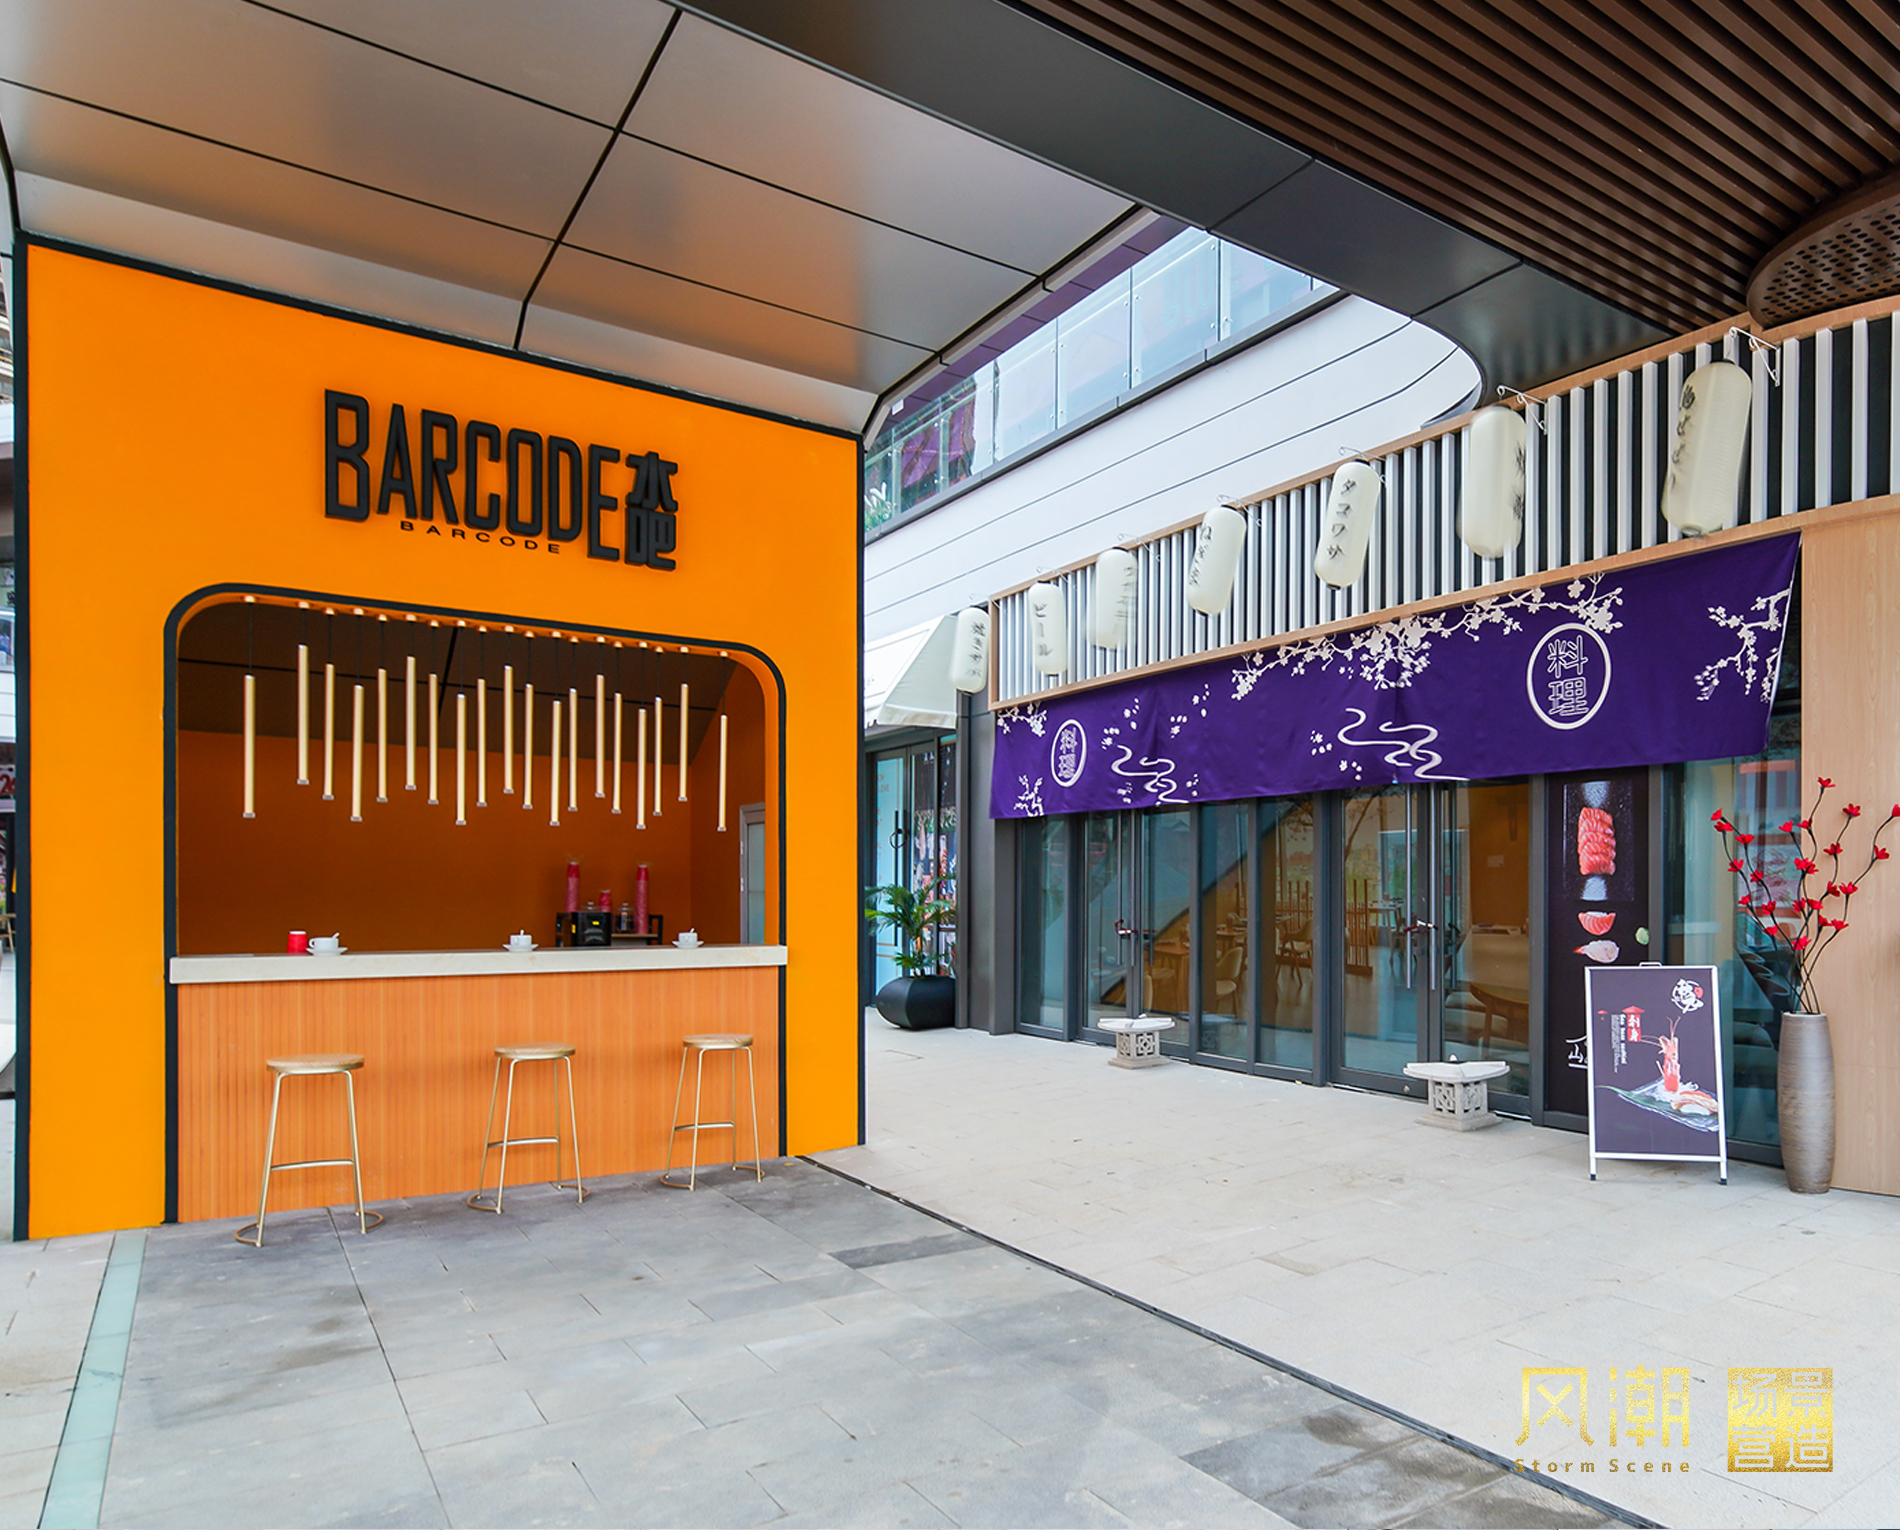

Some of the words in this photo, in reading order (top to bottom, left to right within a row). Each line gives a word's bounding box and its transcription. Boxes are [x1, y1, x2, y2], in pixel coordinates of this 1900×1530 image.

[324, 388, 621, 562] BARCODE
[399, 520, 561, 554] BARCODE
[1547, 634, 1589, 717] 料理
